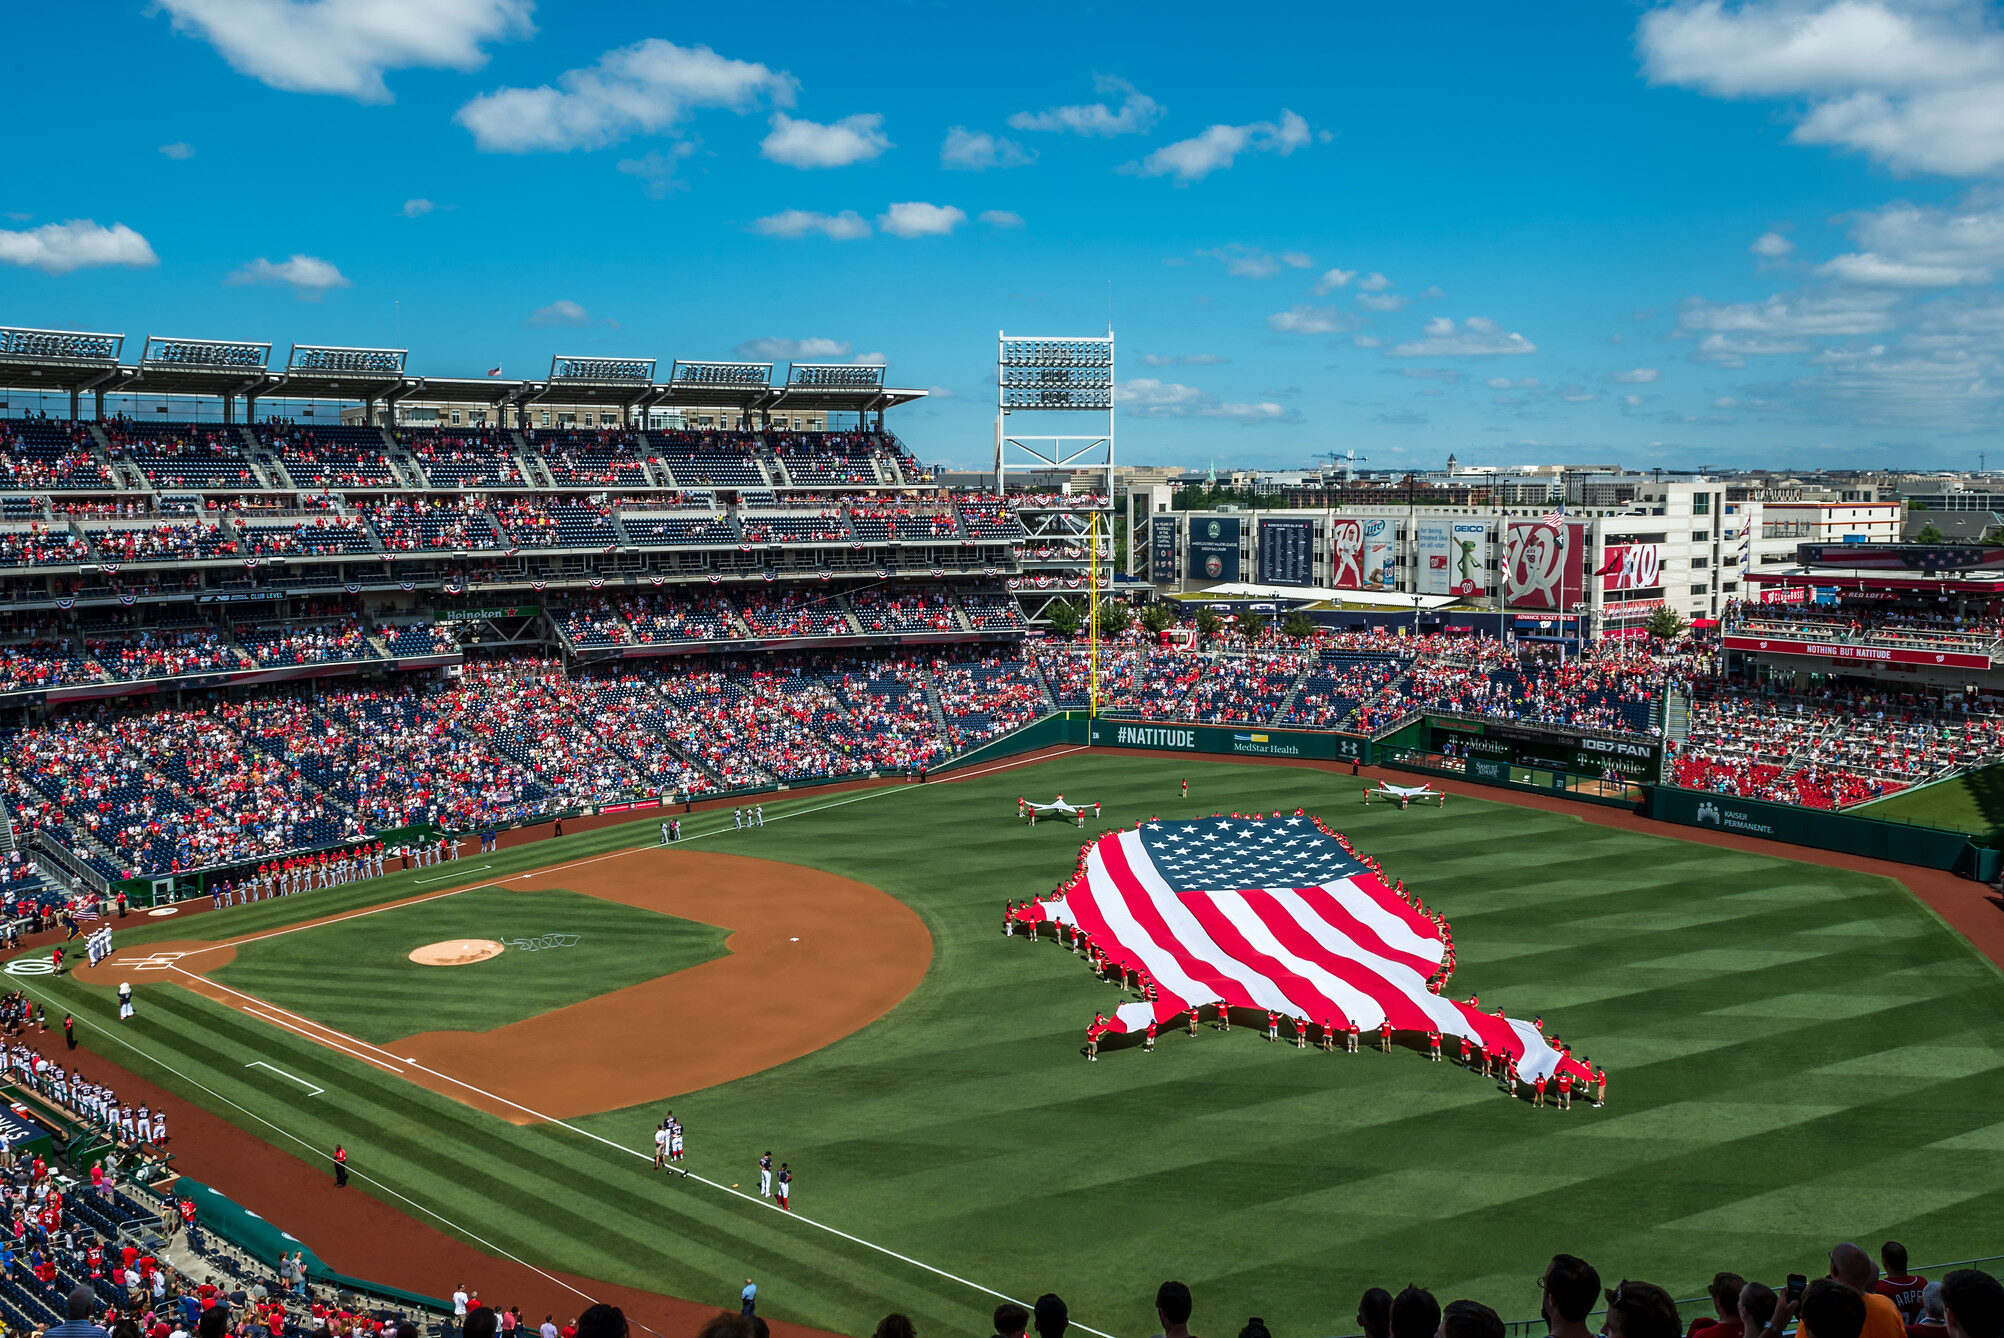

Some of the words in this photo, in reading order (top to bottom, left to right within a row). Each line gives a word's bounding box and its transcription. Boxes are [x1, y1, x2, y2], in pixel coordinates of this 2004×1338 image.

[447, 610, 502, 620] Heineken
[1807, 645, 1837, 655] NOTHING
[1840, 647, 1854, 656] BUT
[1856, 649, 1891, 659] NATITUDE
[1118, 727, 1195, 748] #NATITUDE
[1234, 743, 1269, 753] MedStar
[1270, 744, 1299, 754] Health
[1617, 743, 1650, 758] FAN
[1724, 811, 1747, 820] KAISER
[1724, 820, 1772, 833] PERMANENTE
[1894, 1290, 1923, 1306] ARPE
